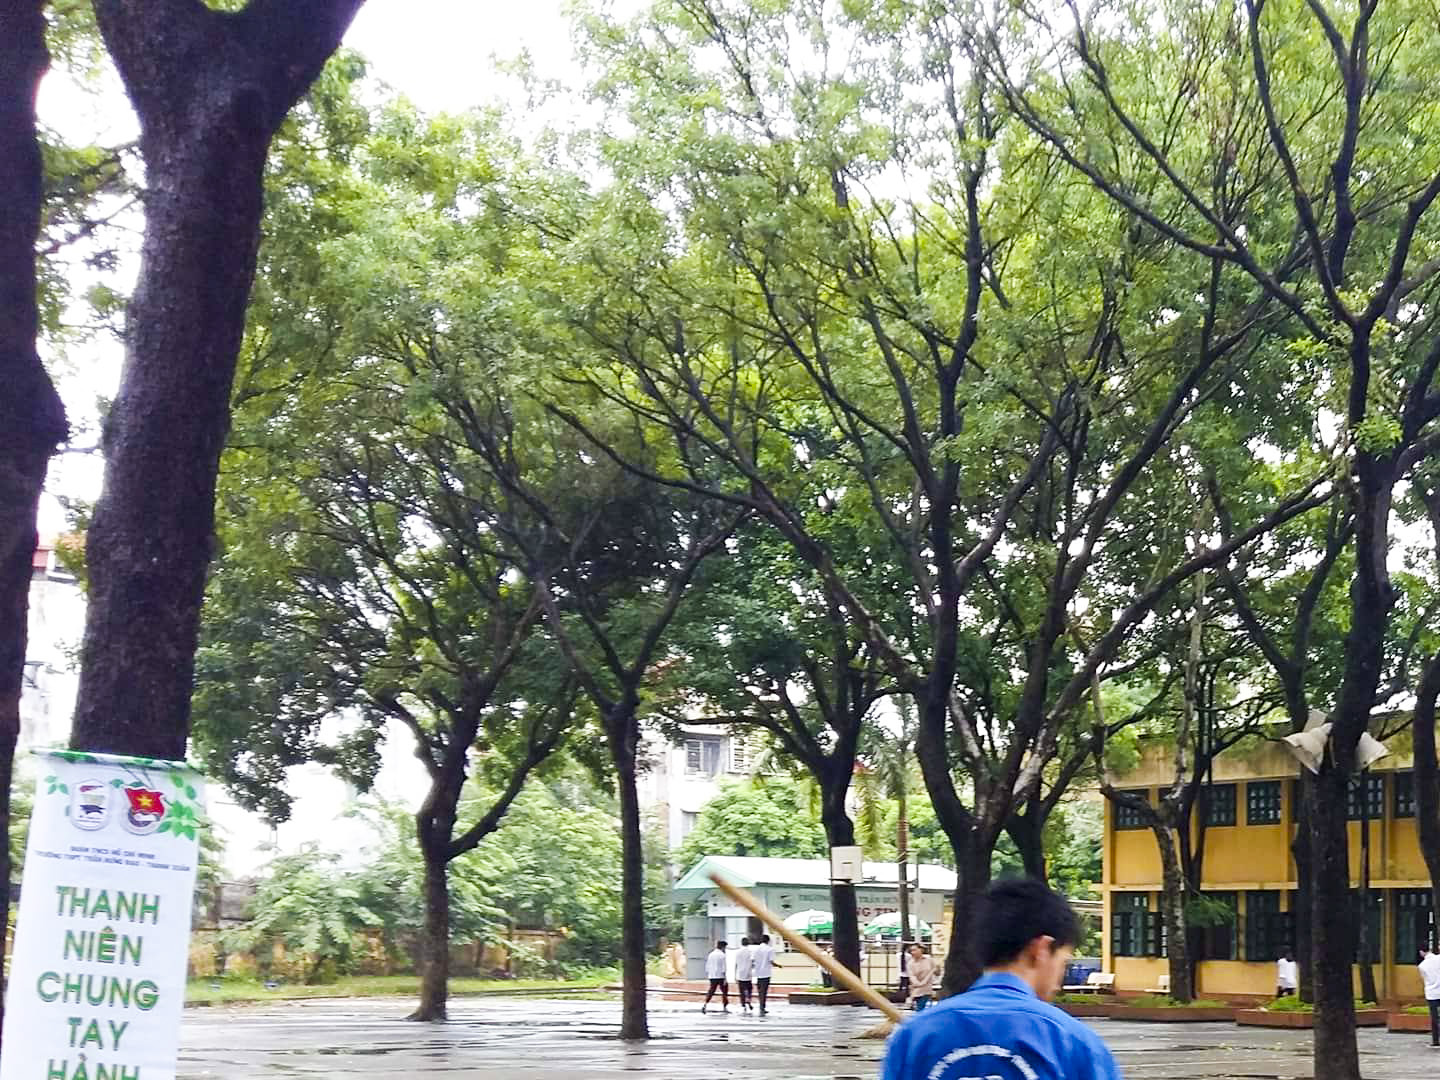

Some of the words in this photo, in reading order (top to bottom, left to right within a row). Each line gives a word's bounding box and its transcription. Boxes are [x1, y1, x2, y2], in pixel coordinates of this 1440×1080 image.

[56, 885, 161, 925] THANH
[63, 926, 143, 966] NIÊN
[36, 971, 160, 1011] CHUNG
[67, 1017, 129, 1051] TAY
